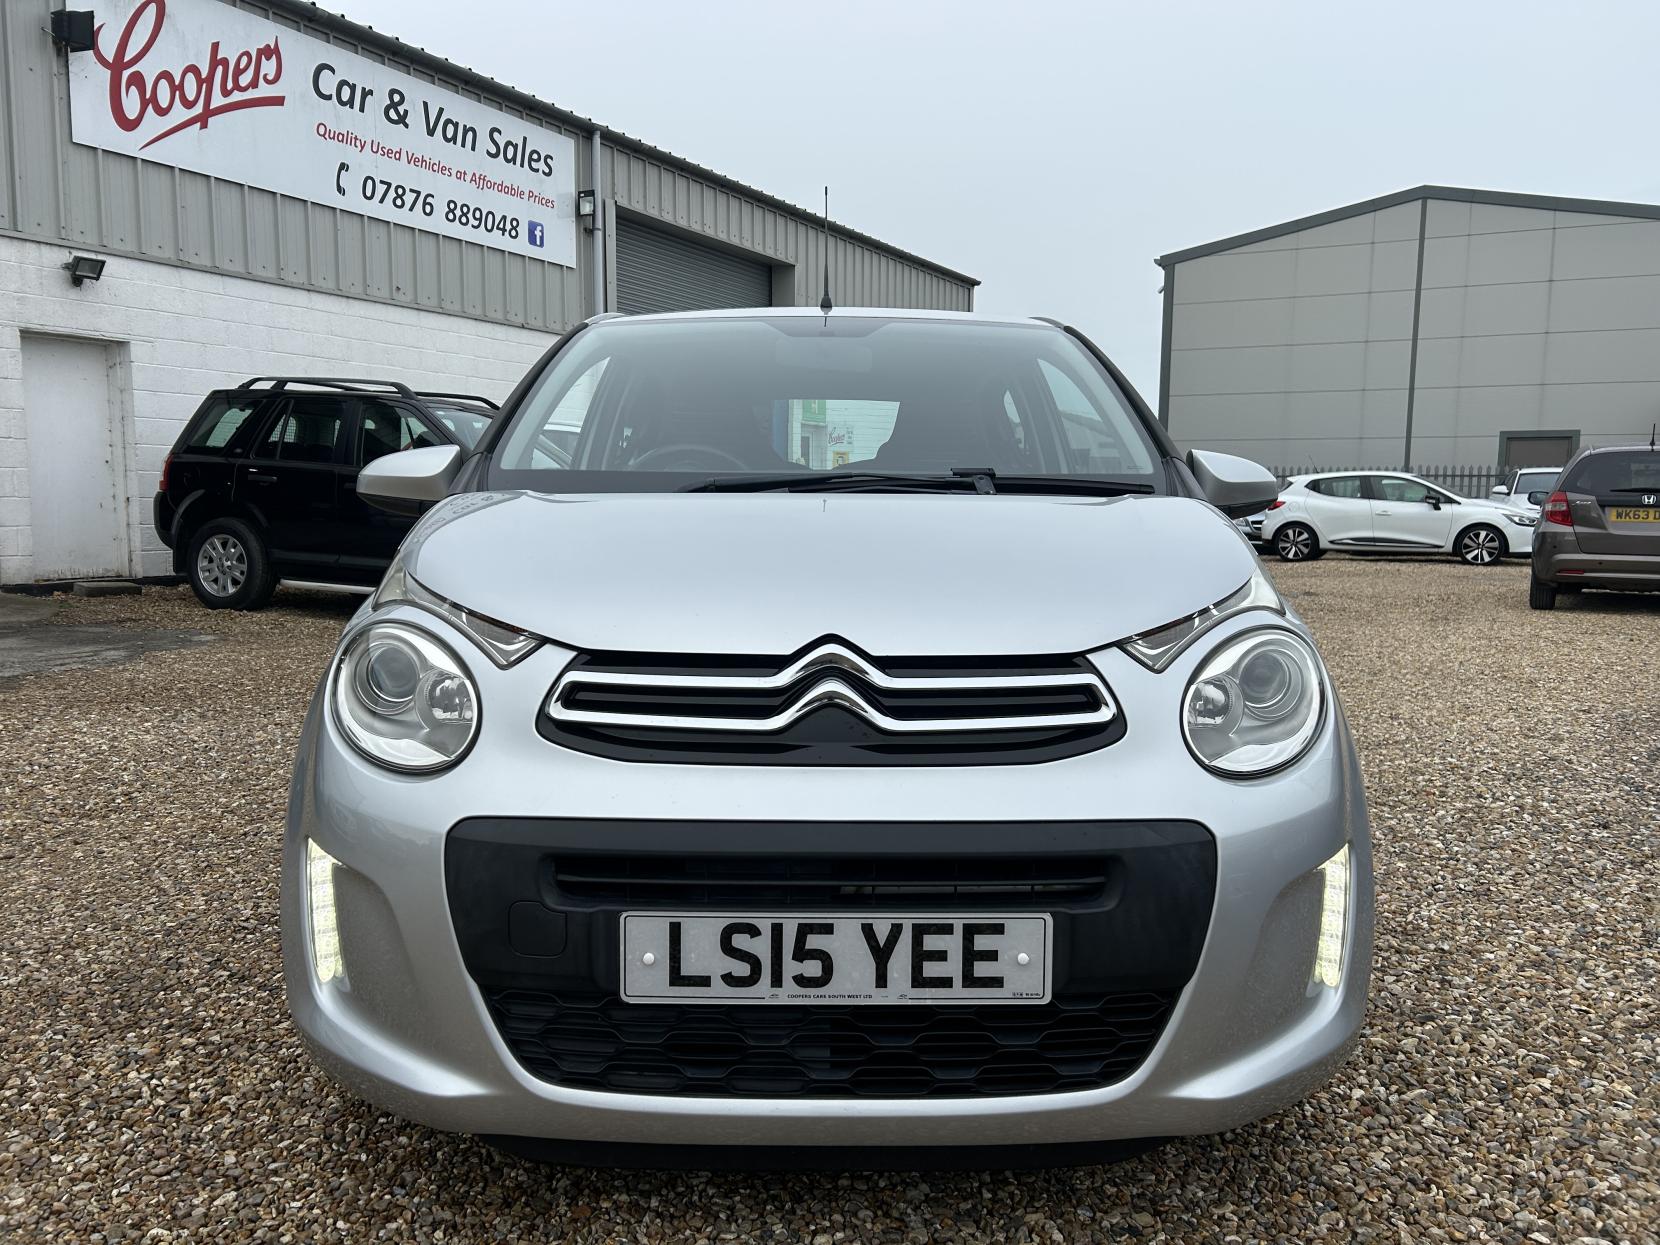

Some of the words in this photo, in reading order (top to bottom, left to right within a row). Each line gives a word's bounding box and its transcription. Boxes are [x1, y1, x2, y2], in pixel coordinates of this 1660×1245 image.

[93, 0, 283, 131] Coopers
[312, 62, 373, 113] Car
[383, 88, 409, 129] &
[422, 100, 477, 152] Van
[486, 126, 554, 177] Sales
[316, 122, 366, 152] Quality
[370, 140, 402, 161] Used
[406, 150, 452, 177] Vehicles
[455, 169, 467, 182] at
[469, 172, 525, 199] Affordable
[528, 189, 555, 209] Prices
[362, 175, 435, 217] 07876
[445, 199, 520, 240] 889048
[1616, 509, 1650, 520] WK63
[668, 921, 834, 988] LS15
[861, 922, 1005, 988] YEE
